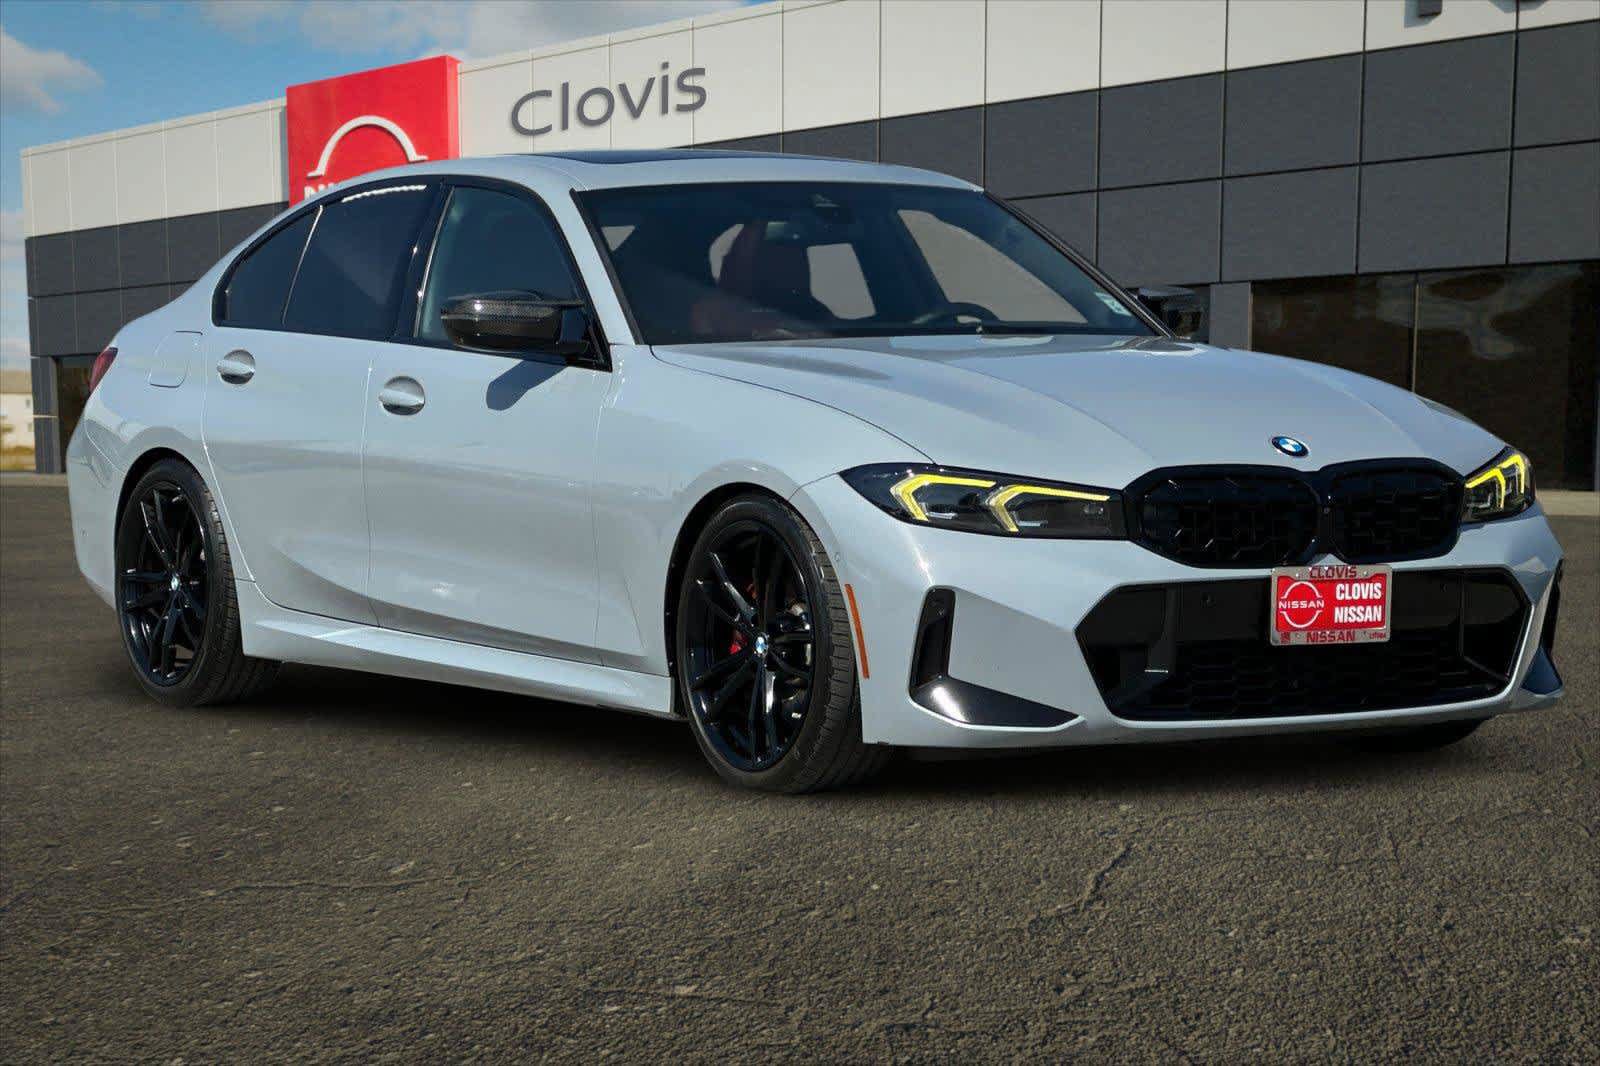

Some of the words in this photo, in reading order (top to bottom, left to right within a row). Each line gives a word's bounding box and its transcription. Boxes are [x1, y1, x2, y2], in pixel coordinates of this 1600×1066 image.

[511, 61, 707, 136] Clovis
[1309, 565, 1357, 578] CLOVIS
[1335, 582, 1382, 600] CLOVIS
[1278, 599, 1325, 609] NISSAN
[1334, 605, 1382, 623] NISSAN
[1306, 631, 1355, 643] NISSAN
